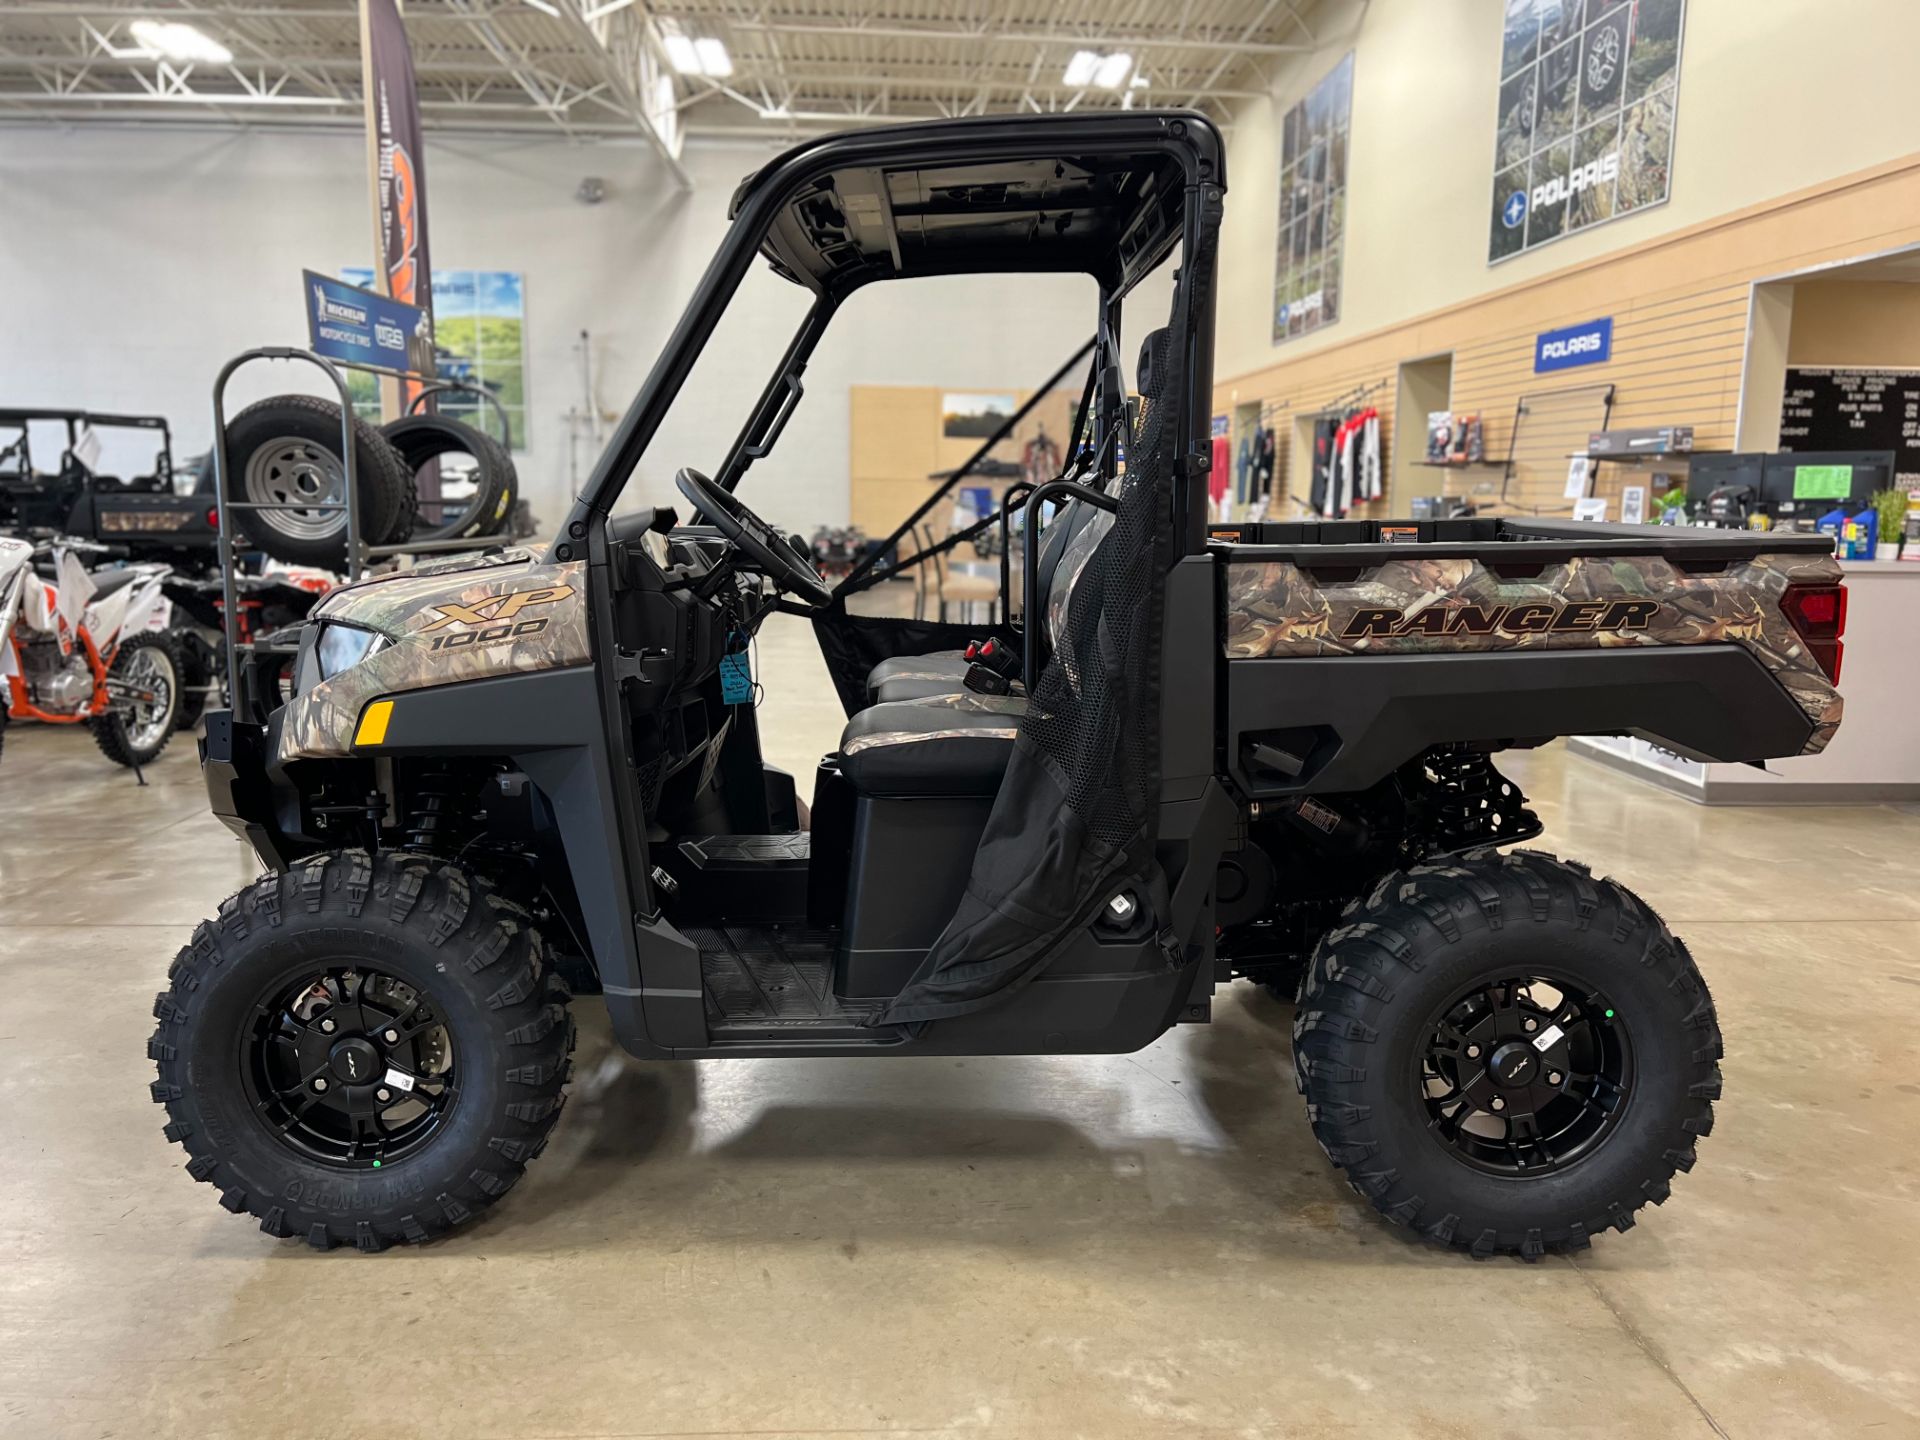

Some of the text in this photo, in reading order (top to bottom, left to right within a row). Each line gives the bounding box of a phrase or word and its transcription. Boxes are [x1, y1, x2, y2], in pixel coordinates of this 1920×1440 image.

[1531, 151, 1619, 213] POLARIS
[326, 302, 366, 322] MICHELIN
[1541, 332, 1602, 360] POLARIS
[417, 584, 577, 633] XP
[1341, 600, 1660, 638] RANGER
[430, 617, 549, 651] 1000
